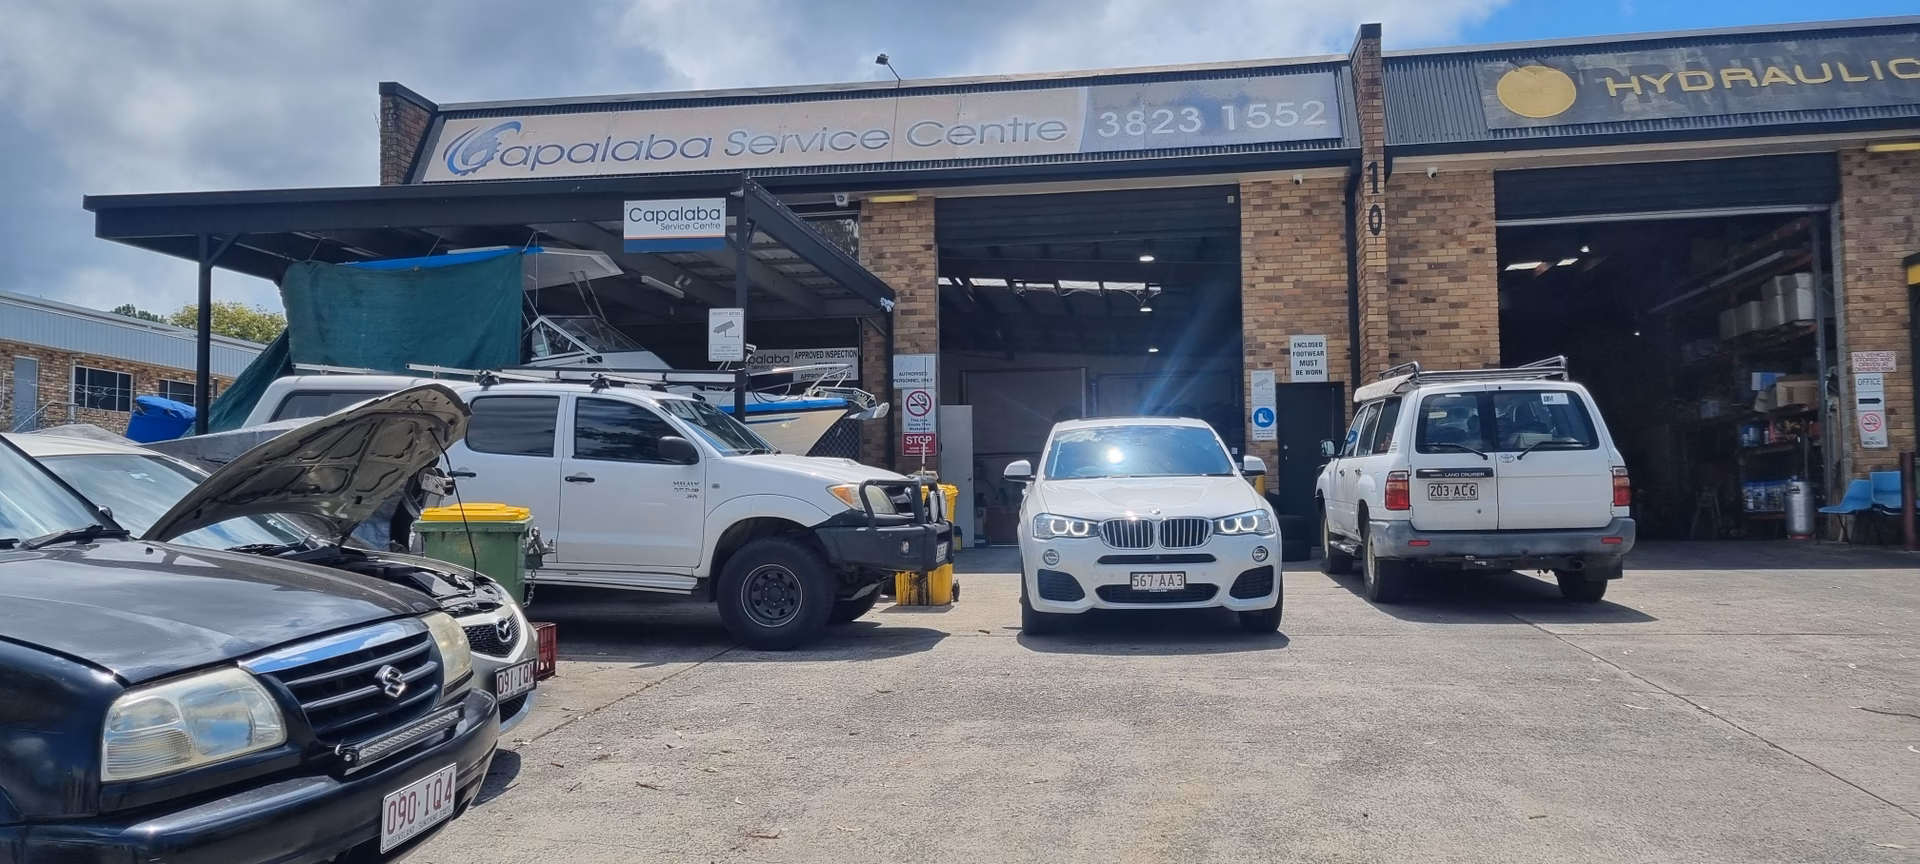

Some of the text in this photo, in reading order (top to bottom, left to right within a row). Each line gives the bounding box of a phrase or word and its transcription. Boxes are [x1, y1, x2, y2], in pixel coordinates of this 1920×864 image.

[443, 100, 1327, 177] Capalaba Service Centre 3823 1552
[629, 206, 721, 225] Capalaba
[660, 221, 721, 230] Service Centre
[748, 353, 790, 366] palaba
[794, 350, 858, 360] APPROVED INSPECTION
[906, 435, 932, 444] STOP
